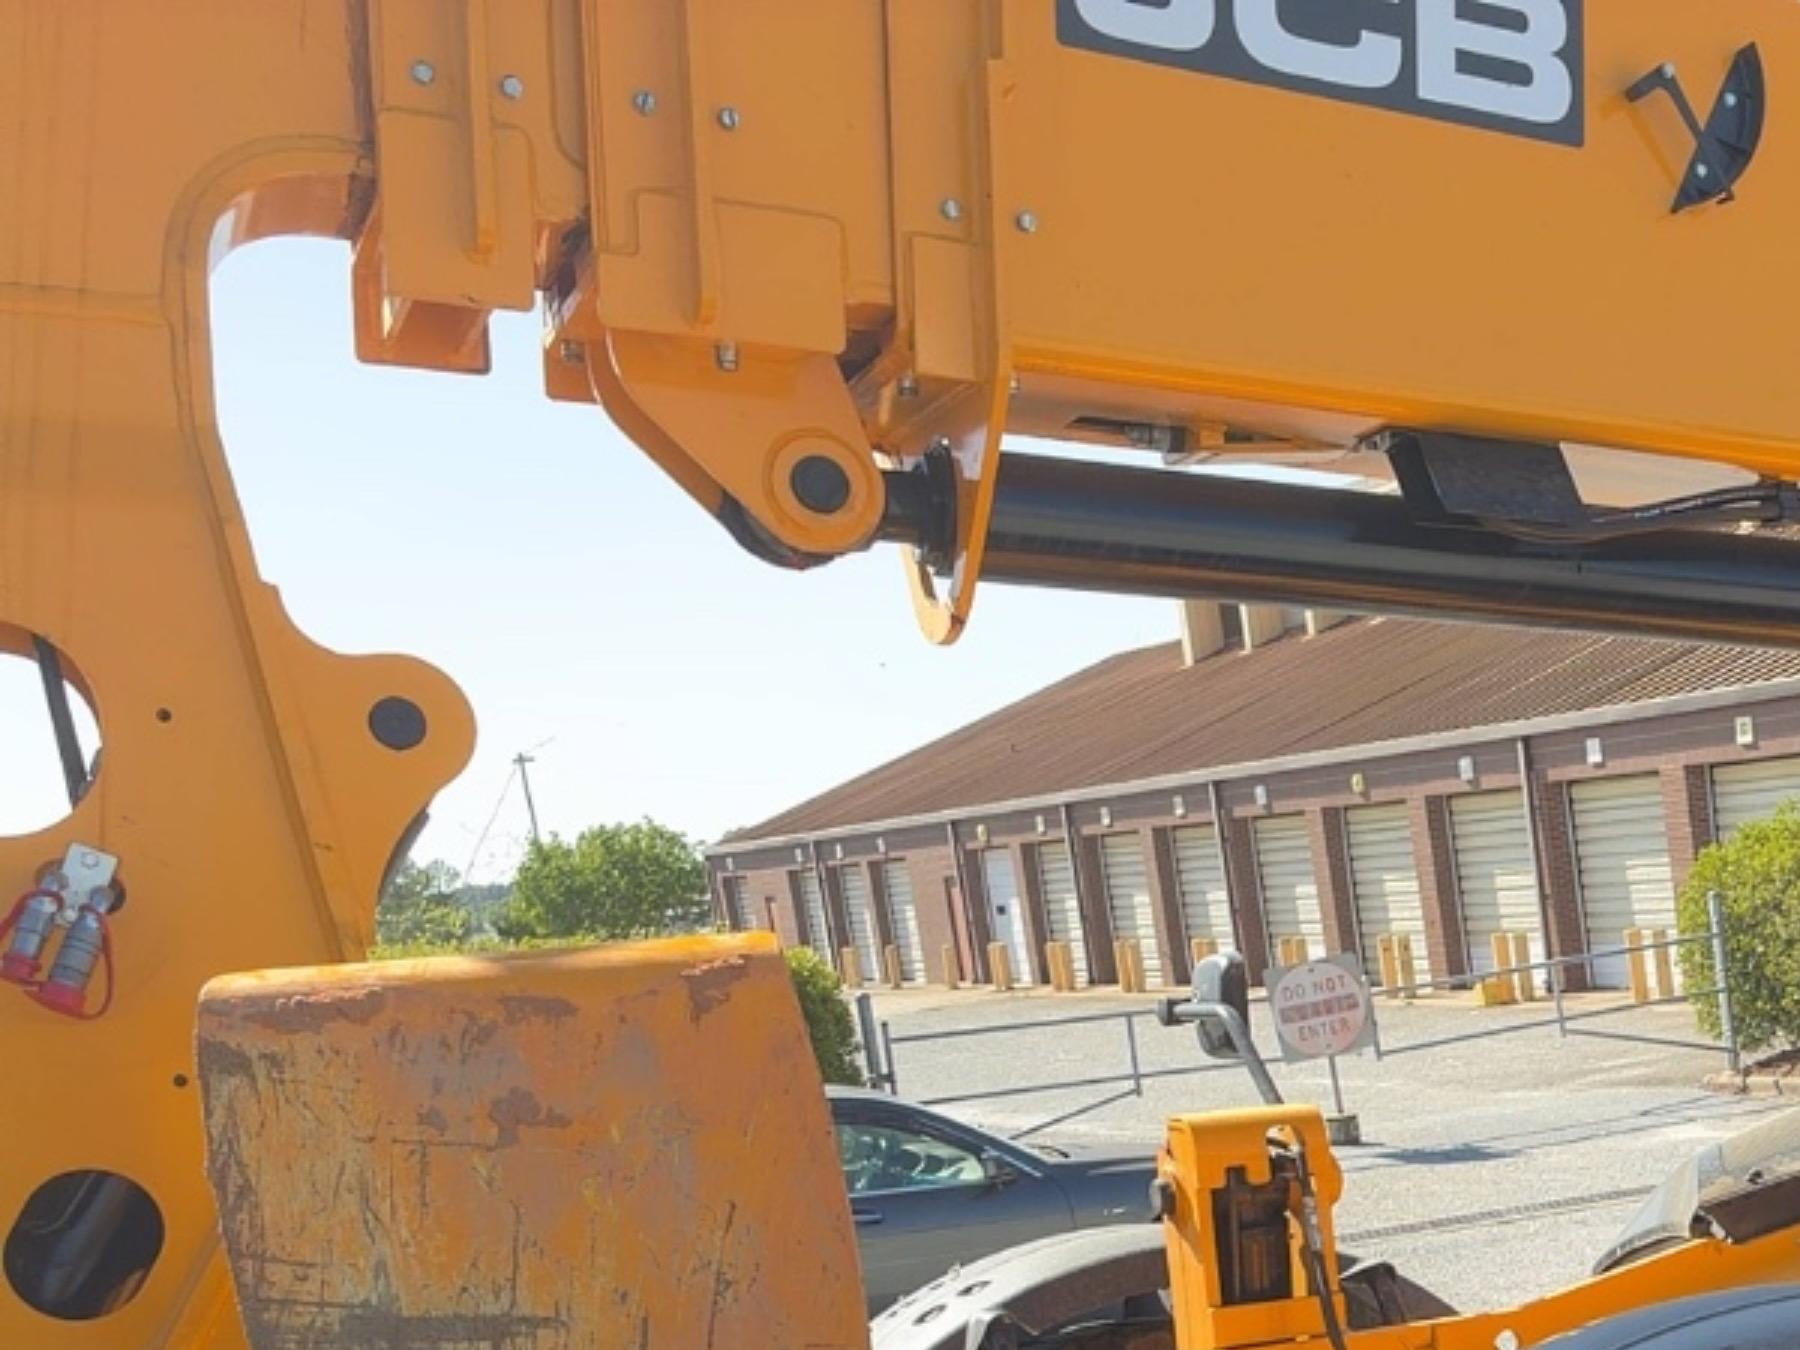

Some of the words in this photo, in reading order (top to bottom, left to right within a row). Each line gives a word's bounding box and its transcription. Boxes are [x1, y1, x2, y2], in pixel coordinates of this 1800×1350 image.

[1283, 983, 1304, 1002] DO
[1312, 974, 1345, 996] NOT
[1298, 1017, 1351, 1041] ENTER
